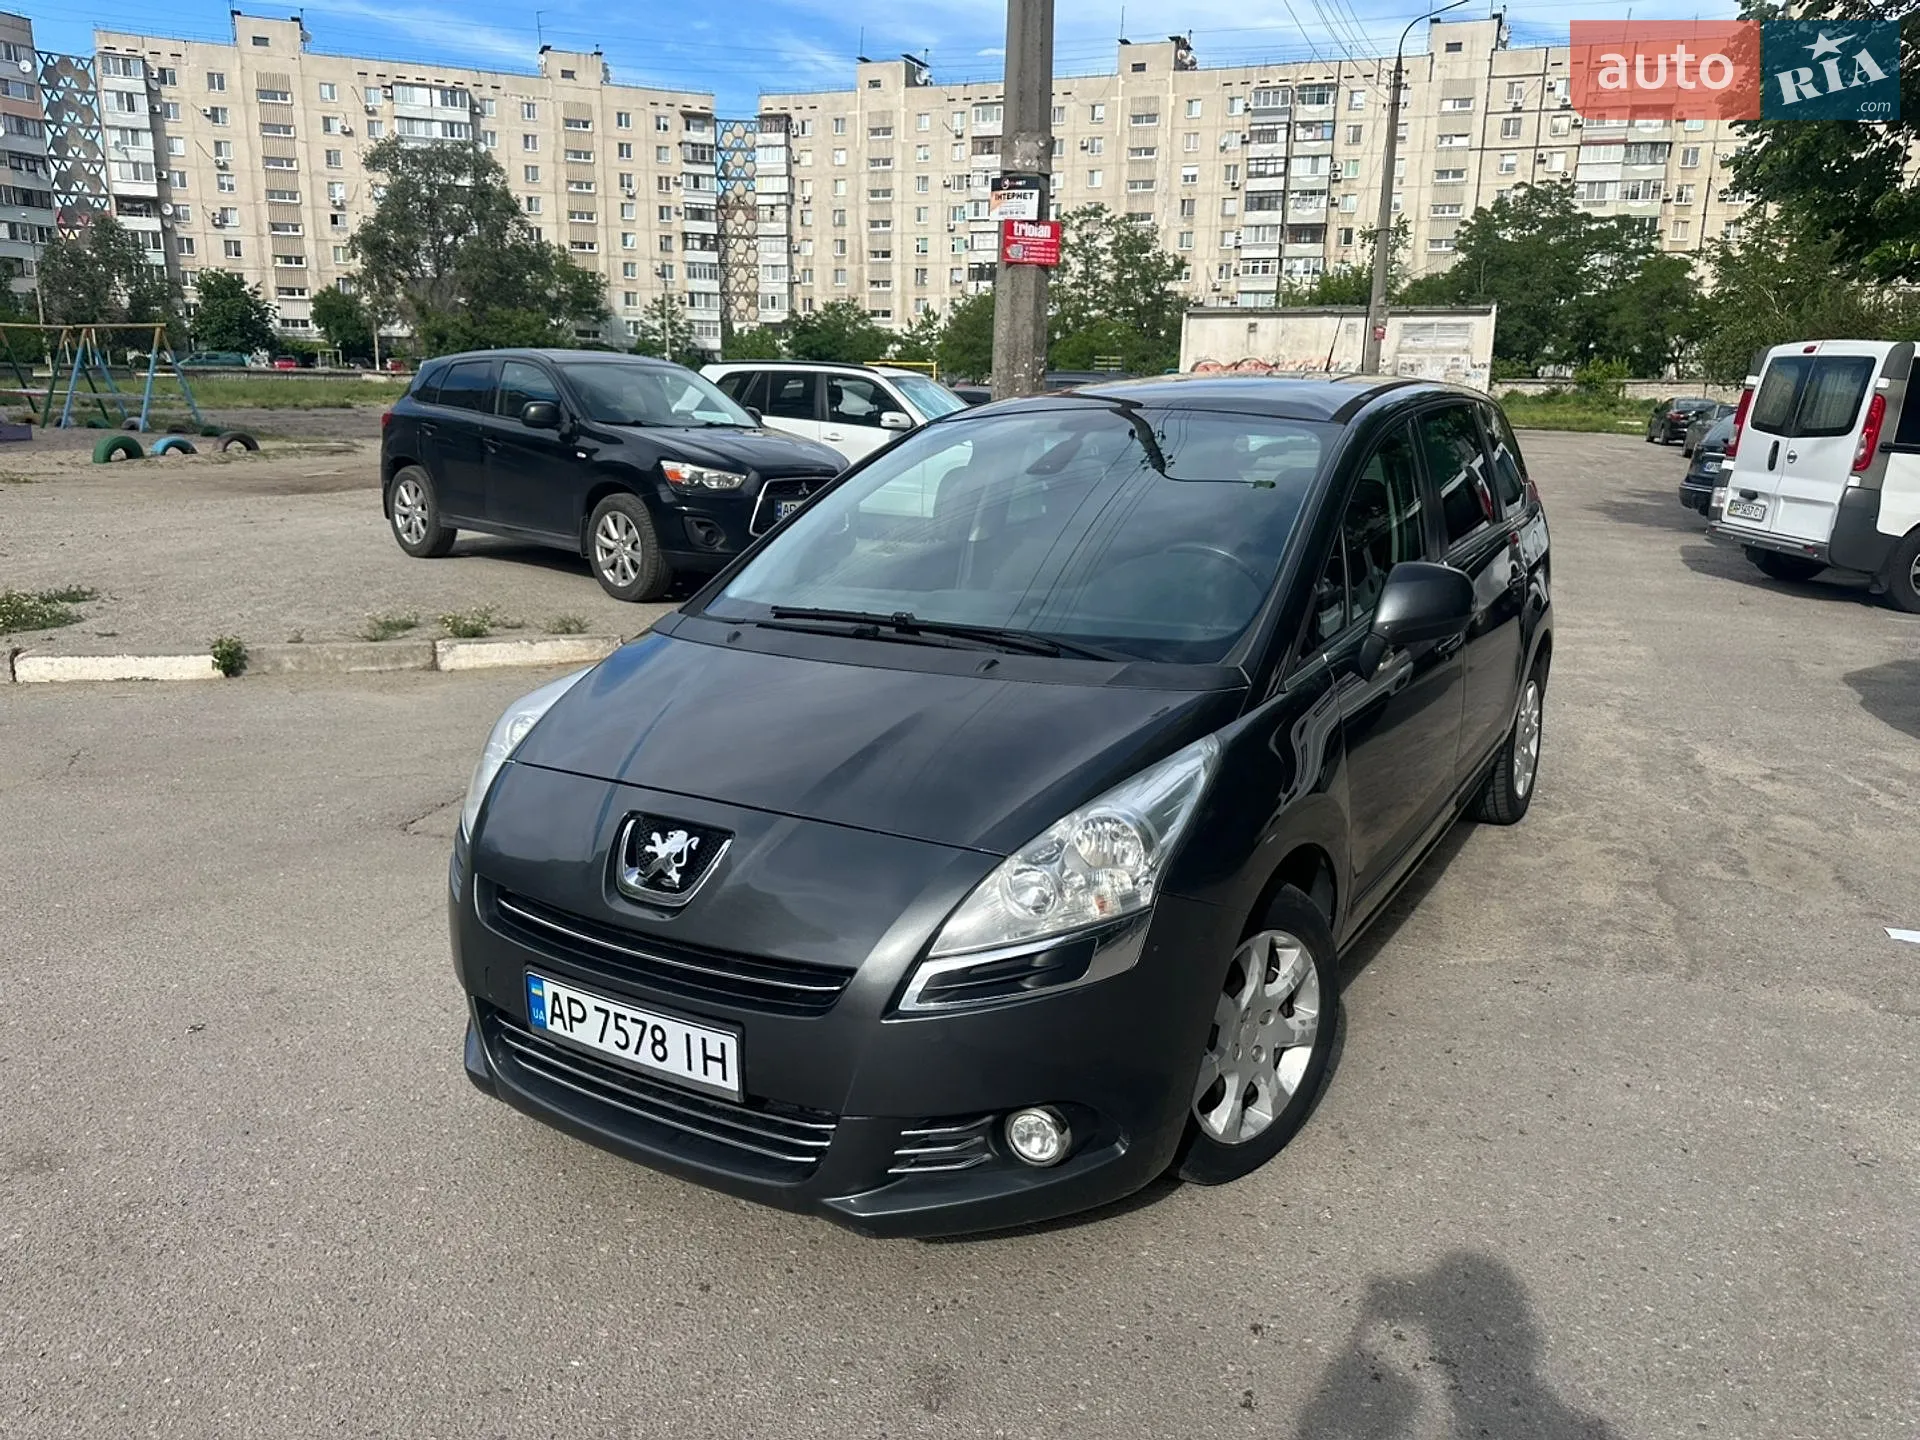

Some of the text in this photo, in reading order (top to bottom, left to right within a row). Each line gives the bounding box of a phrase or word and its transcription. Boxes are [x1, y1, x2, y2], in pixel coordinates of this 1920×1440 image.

[532, 1007, 545, 1022] UA
[550, 991, 727, 1082] AP 7578 IH
